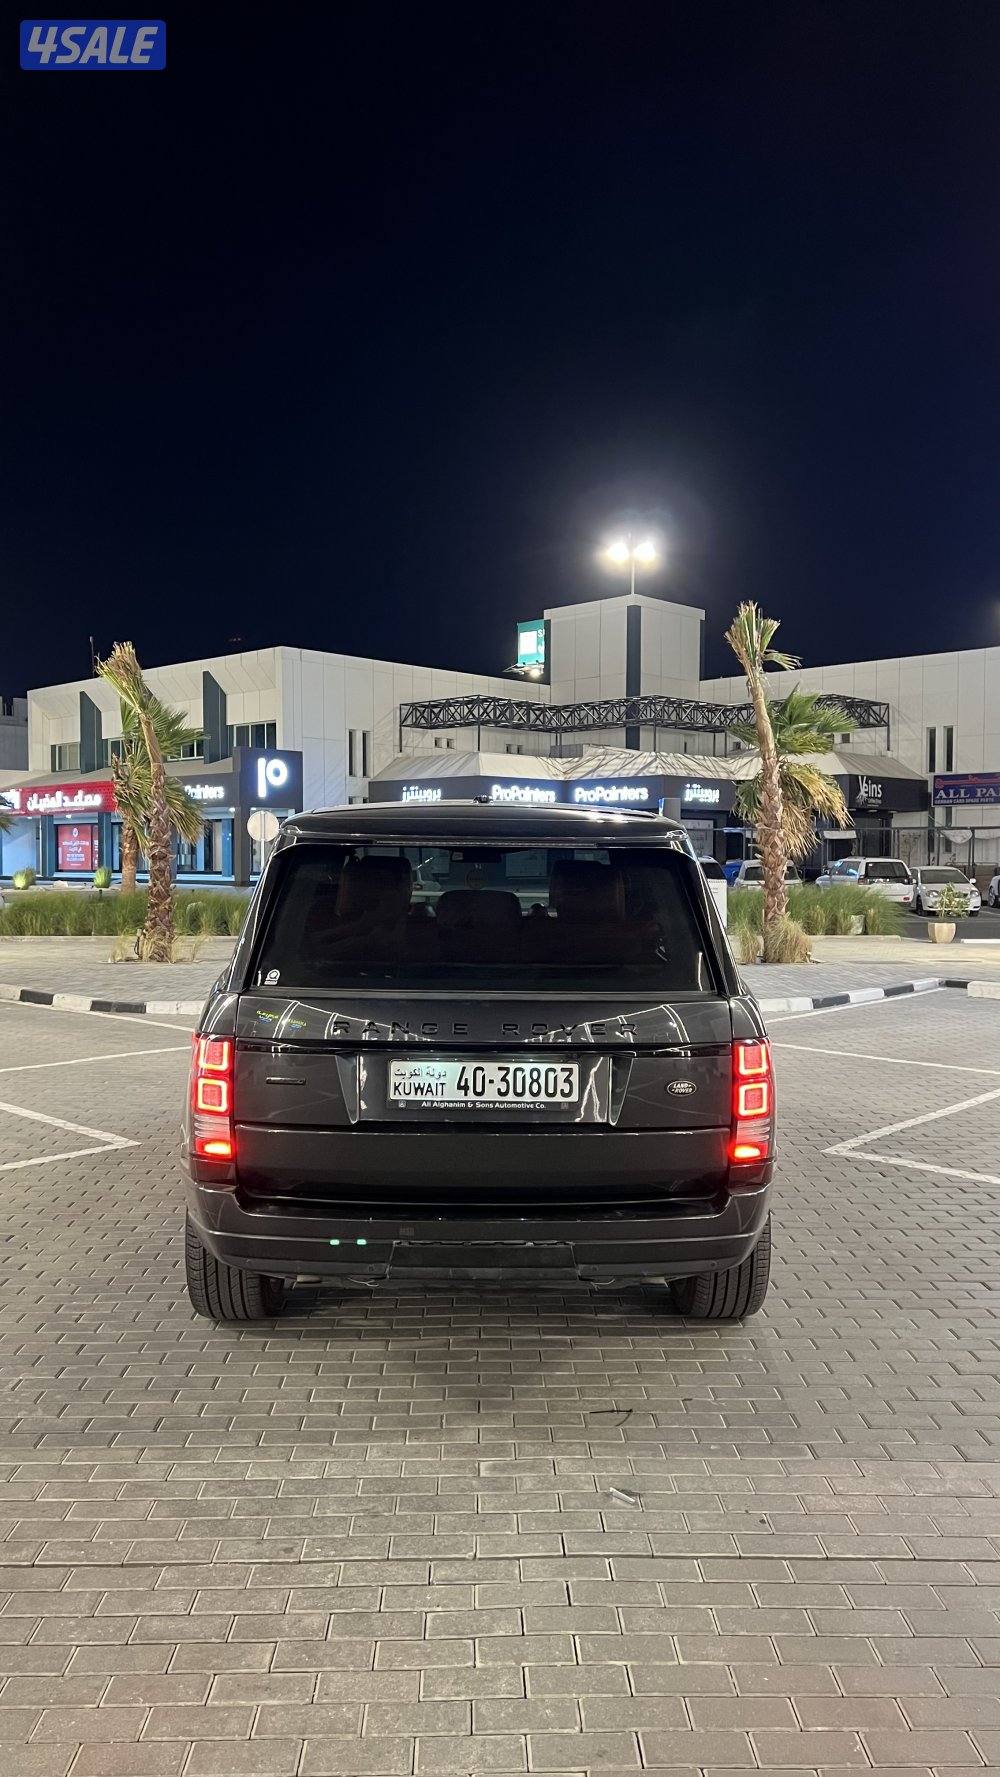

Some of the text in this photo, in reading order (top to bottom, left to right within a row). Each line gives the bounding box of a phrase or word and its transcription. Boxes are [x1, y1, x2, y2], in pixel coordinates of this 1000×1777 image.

[491, 784, 556, 803] ProPainters
[574, 785, 649, 803] ProPainters
[856, 775, 882, 805] Veins
[935, 787, 1000, 799] ALL PA
[333, 1021, 638, 1036] RANGE ROVER
[394, 1066, 447, 1080] دولة الكويت
[393, 1082, 447, 1096] KUWAIT
[456, 1066, 574, 1098] 40-30803
[432, 1101, 466, 1110] Alghanim
[494, 1102, 534, 1110] Automotive
